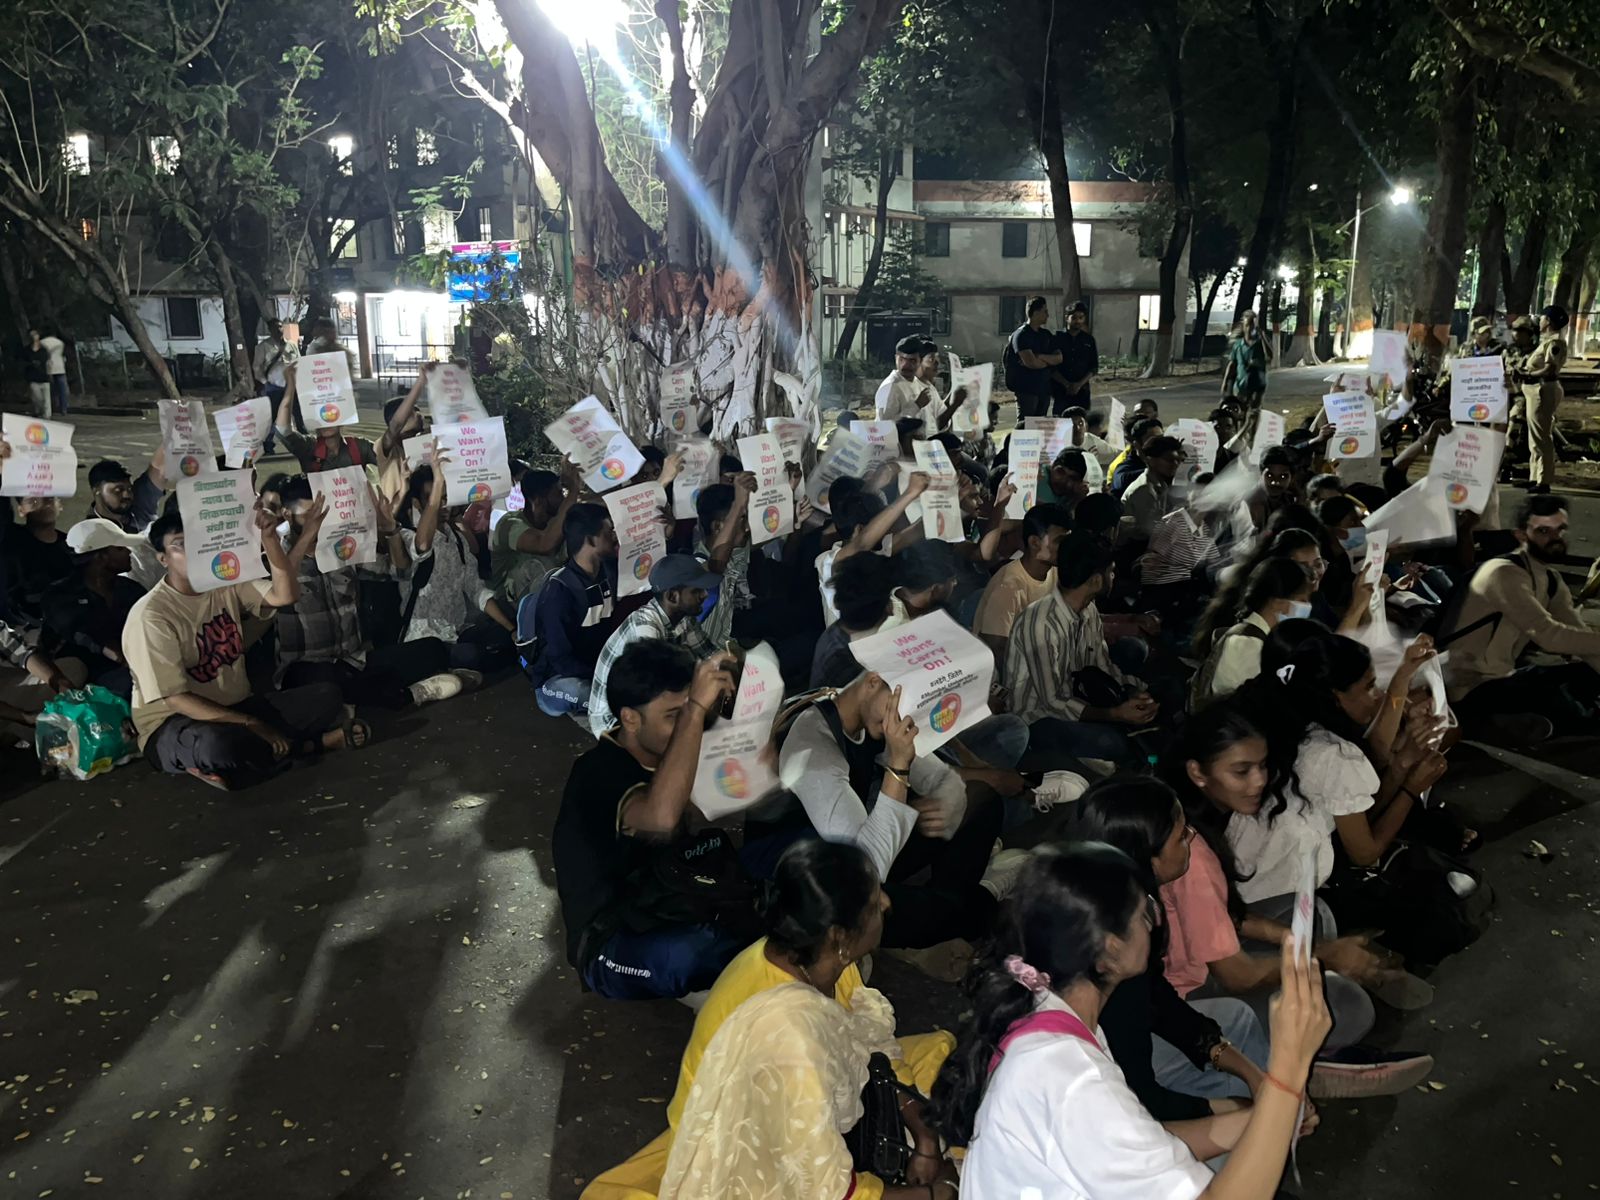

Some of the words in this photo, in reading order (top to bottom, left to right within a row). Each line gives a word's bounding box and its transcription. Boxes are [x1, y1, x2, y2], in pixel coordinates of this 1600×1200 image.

[460, 427, 476, 436] We
[458, 436, 485, 446] Want
[460, 447, 486, 458] Carry
[332, 477, 348, 486] We
[332, 487, 354, 498] Want
[334, 499, 356, 510] Carry
[892, 633, 918, 647] We
[896, 638, 936, 659] Want
[908, 646, 946, 666] Carry
[742, 680, 765, 698] Want
